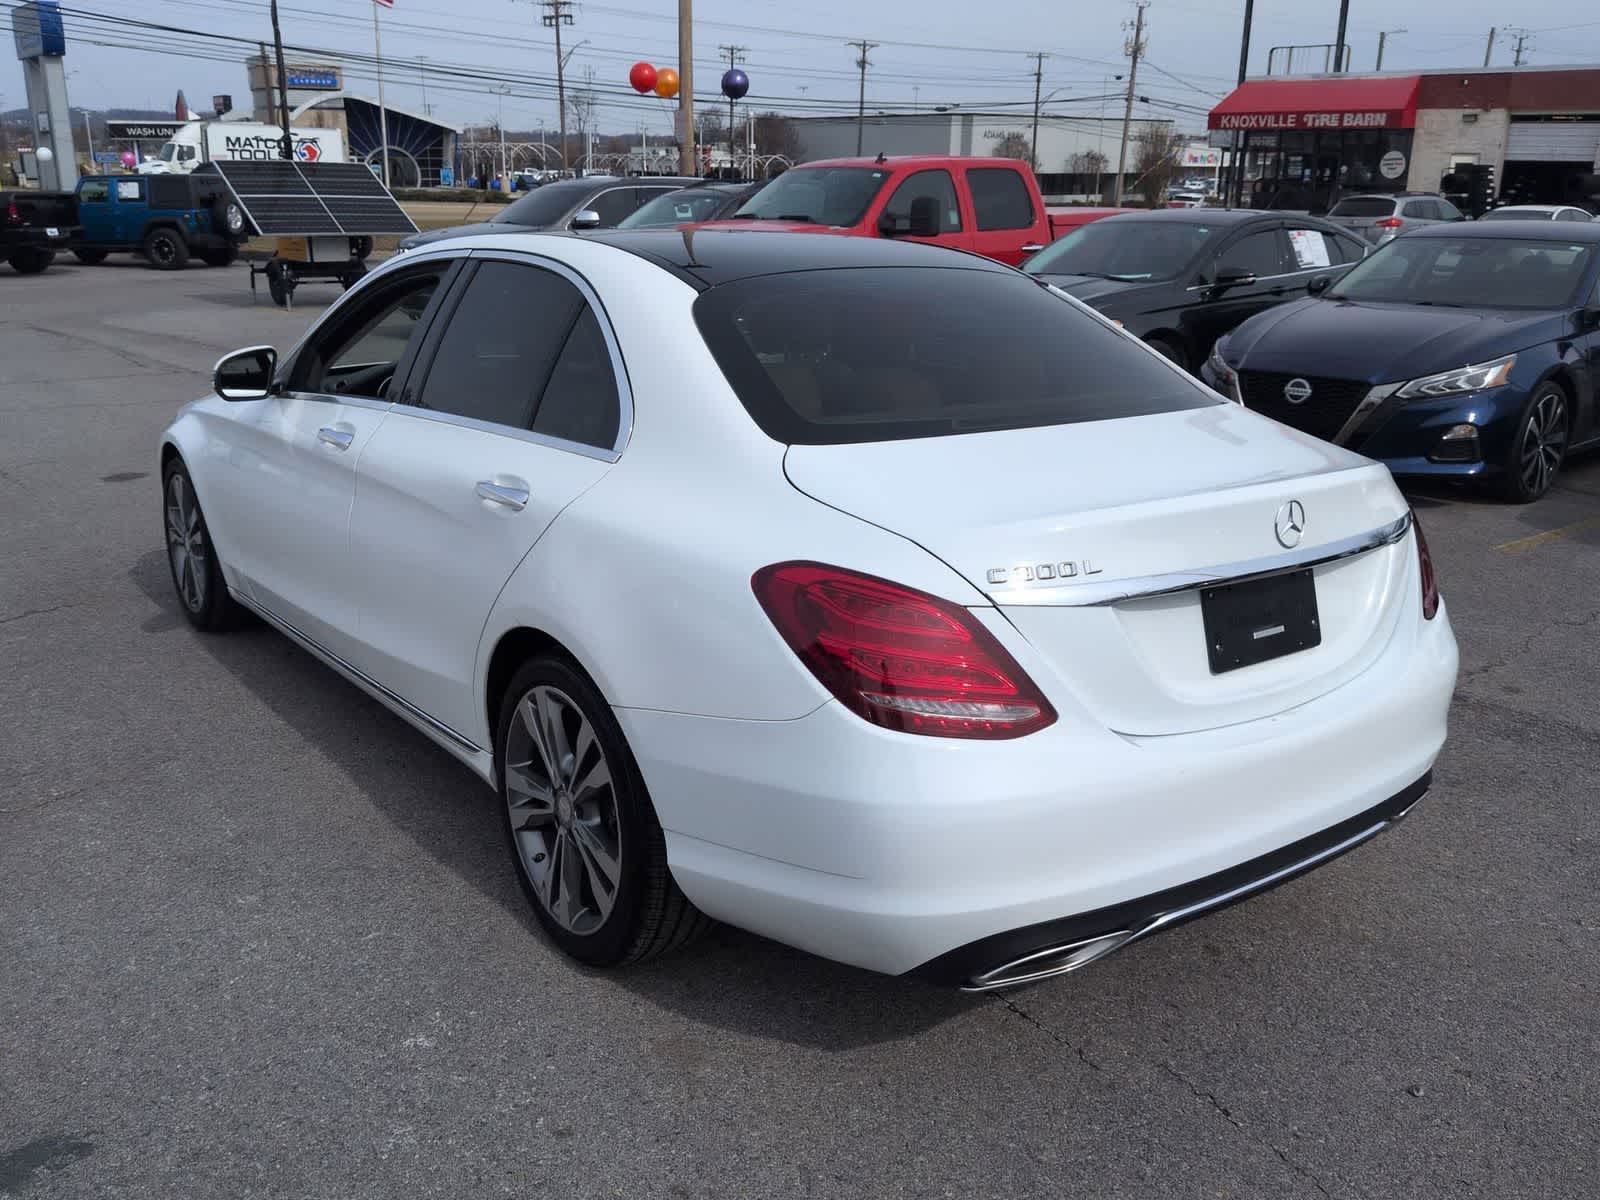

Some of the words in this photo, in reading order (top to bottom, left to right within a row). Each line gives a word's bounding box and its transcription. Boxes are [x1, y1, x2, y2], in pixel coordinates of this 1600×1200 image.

[1220, 114, 1297, 128] KNOXVILLE
[1303, 113, 1340, 127] TIRE
[1343, 112, 1387, 127] BARN
[126, 127, 155, 136] WASH
